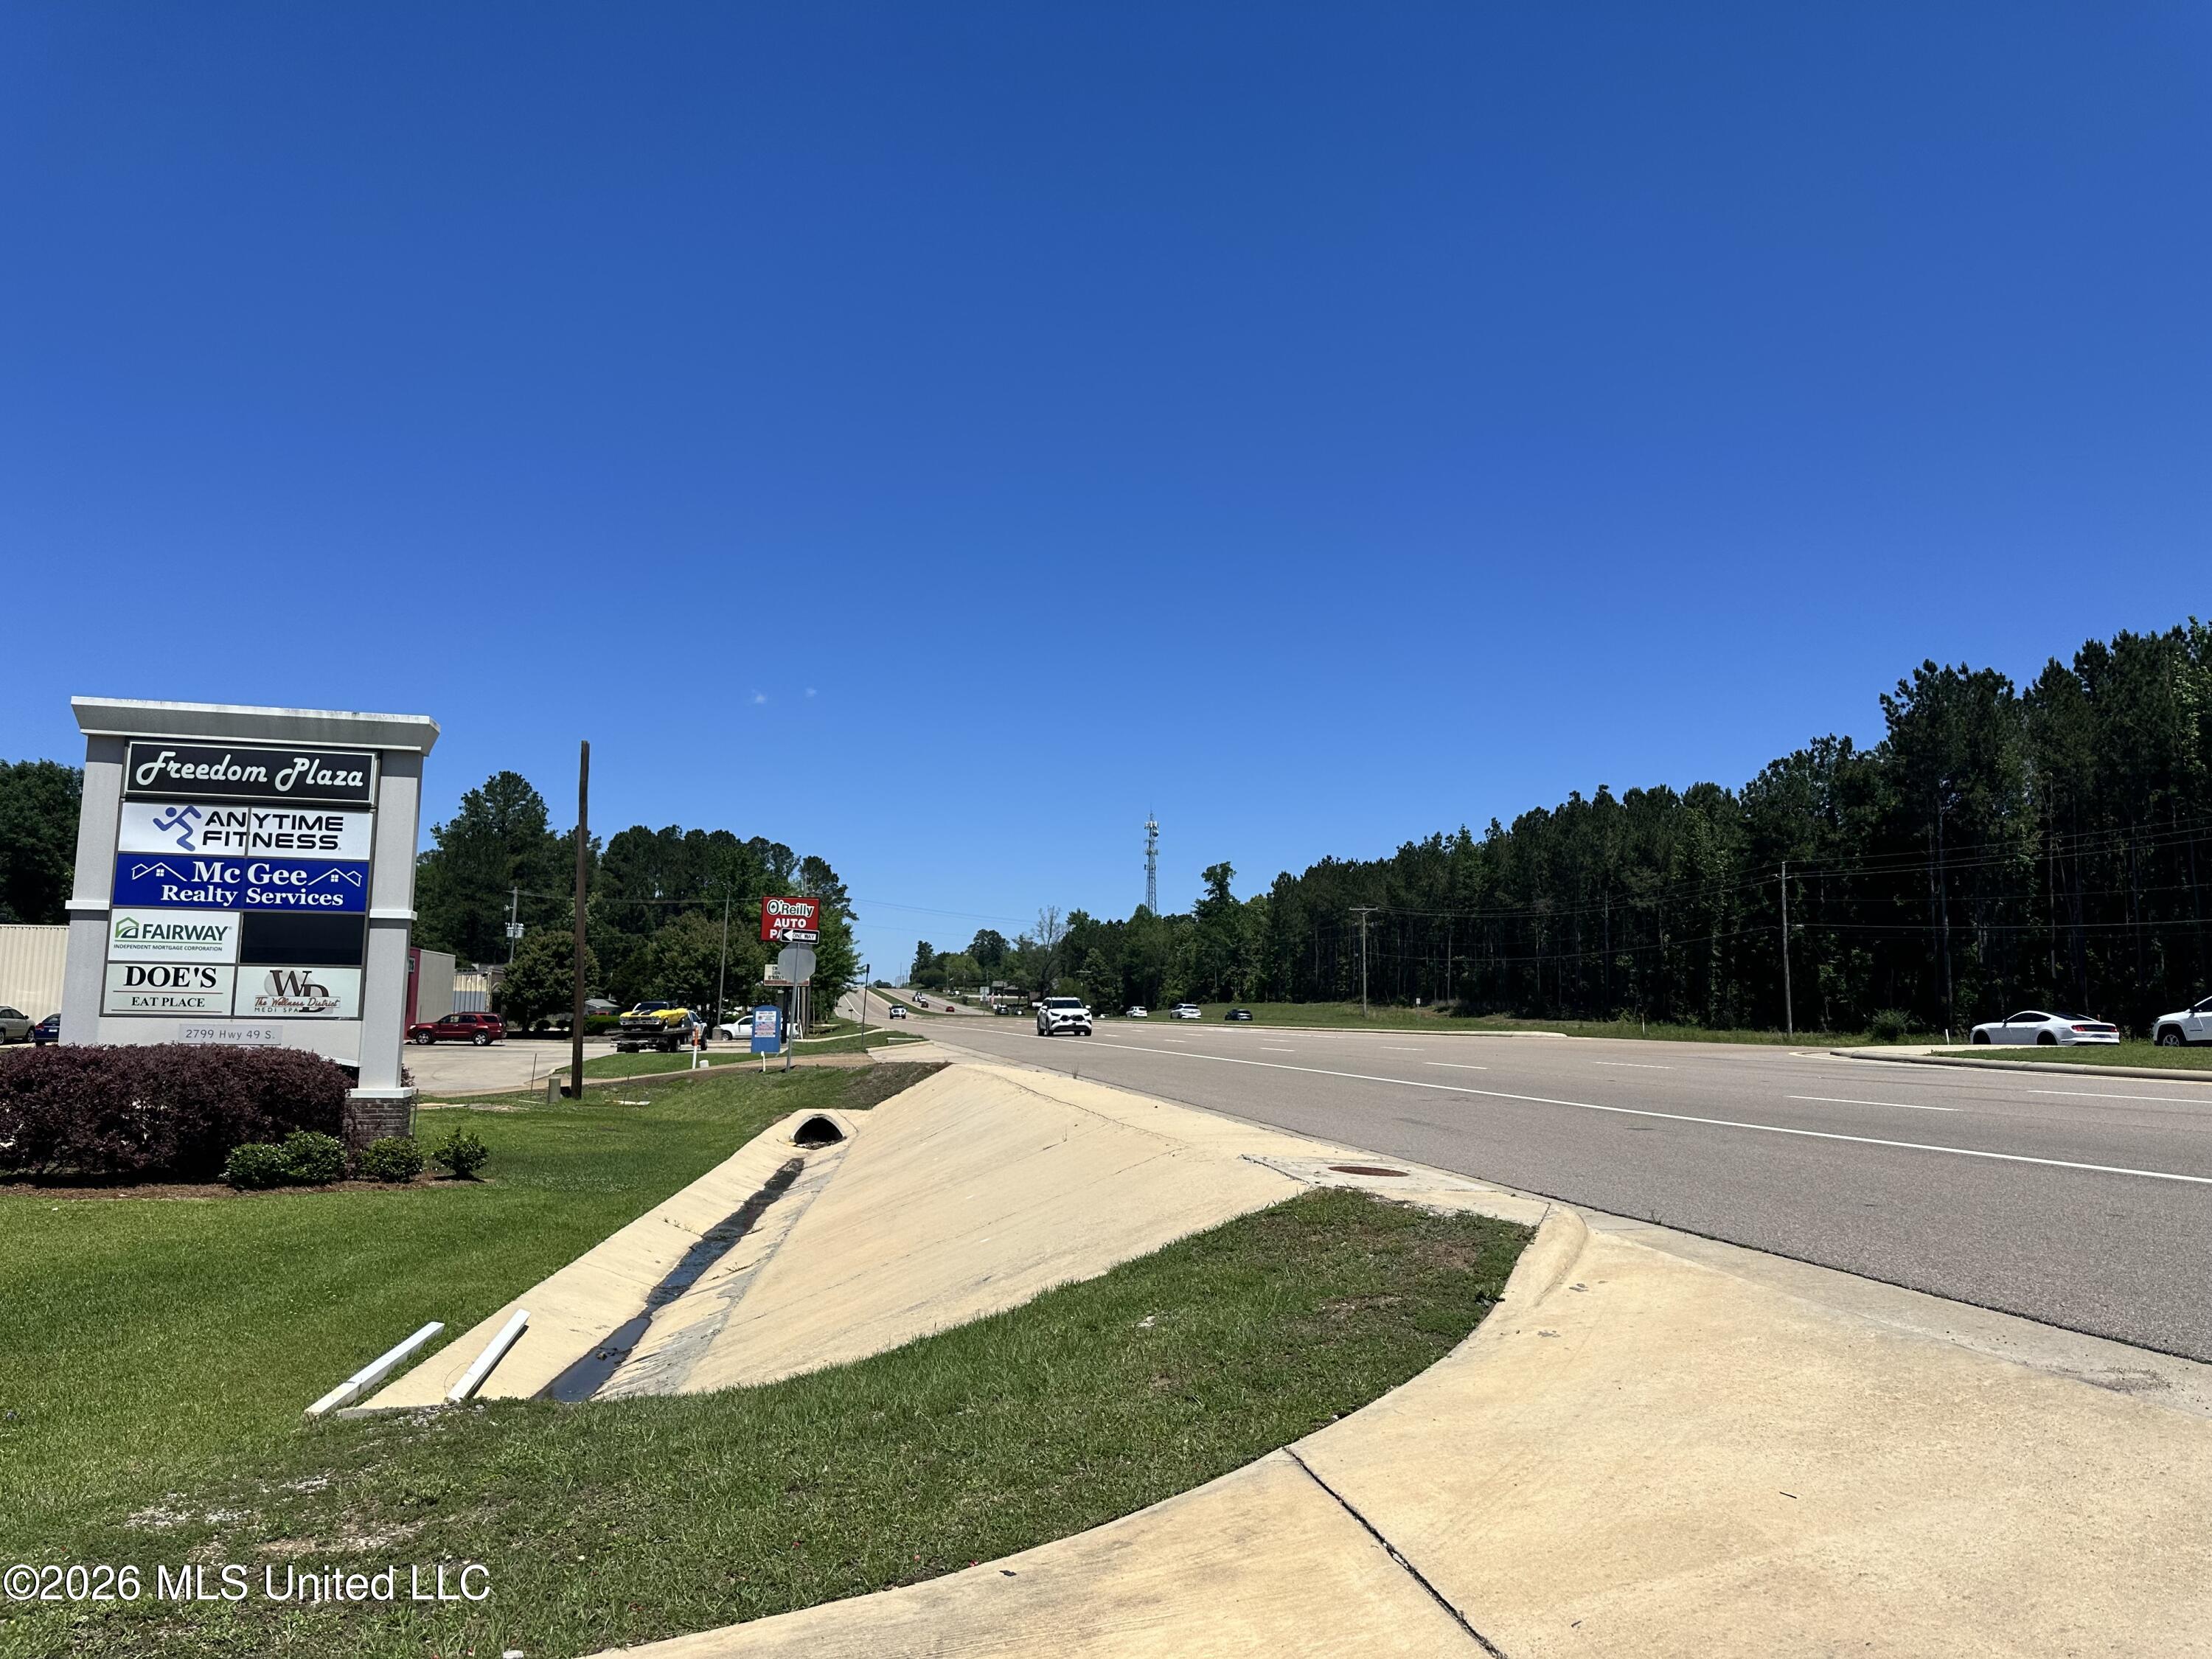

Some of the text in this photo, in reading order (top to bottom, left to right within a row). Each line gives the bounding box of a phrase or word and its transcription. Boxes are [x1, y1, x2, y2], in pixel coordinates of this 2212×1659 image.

[136, 751, 364, 792] Freedom Plaza
[205, 811, 344, 832] ANYTIME
[202, 831, 339, 850] FITNESS
[161, 885, 343, 906] Realty Services
[768, 900, 813, 917] O'Reilly
[773, 918, 807, 928] AUTO
[142, 924, 228, 941] FAIRWAY
[123, 966, 217, 988] DOE'S
[131, 997, 205, 1007] EAT PLACE
[254, 996, 341, 1007] The Wellness District
[186, 1029, 214, 1038] 2799
[219, 1030, 242, 1040] Hwy
[246, 1030, 260, 1038] 49
